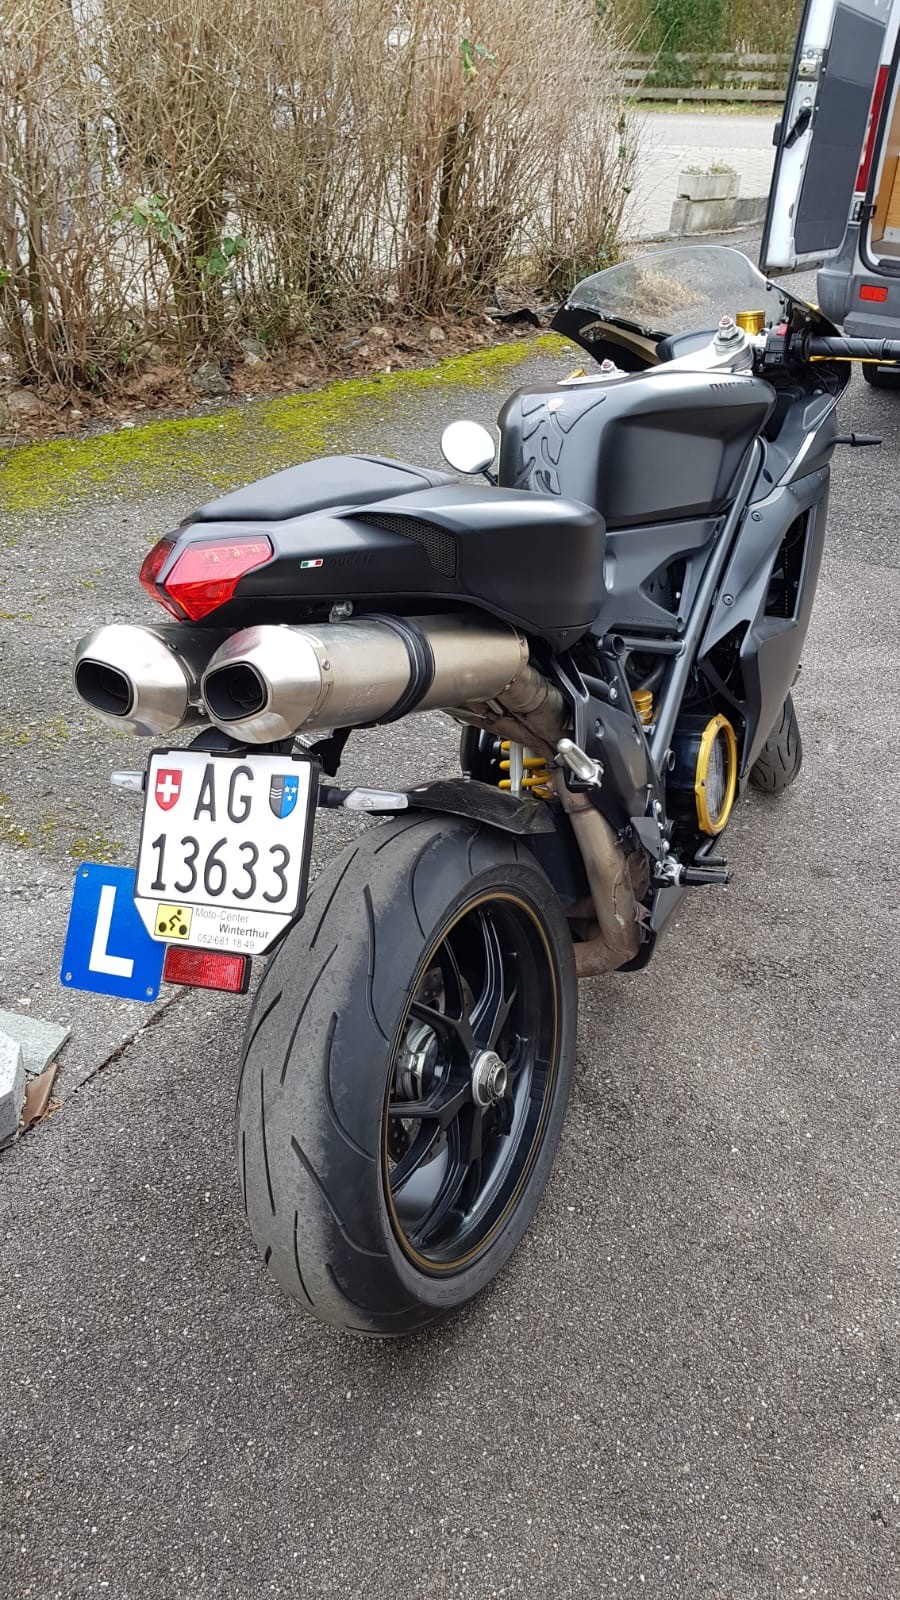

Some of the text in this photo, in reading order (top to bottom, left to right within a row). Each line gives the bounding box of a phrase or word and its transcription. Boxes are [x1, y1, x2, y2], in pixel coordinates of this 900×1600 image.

[709, 379, 753, 392] DUCA
[193, 763, 255, 824] AG
[150, 833, 291, 904] 13633
[88, 884, 135, 978] L
[195, 907, 249, 923] Moto-Center
[219, 923, 269, 939] Winterthur
